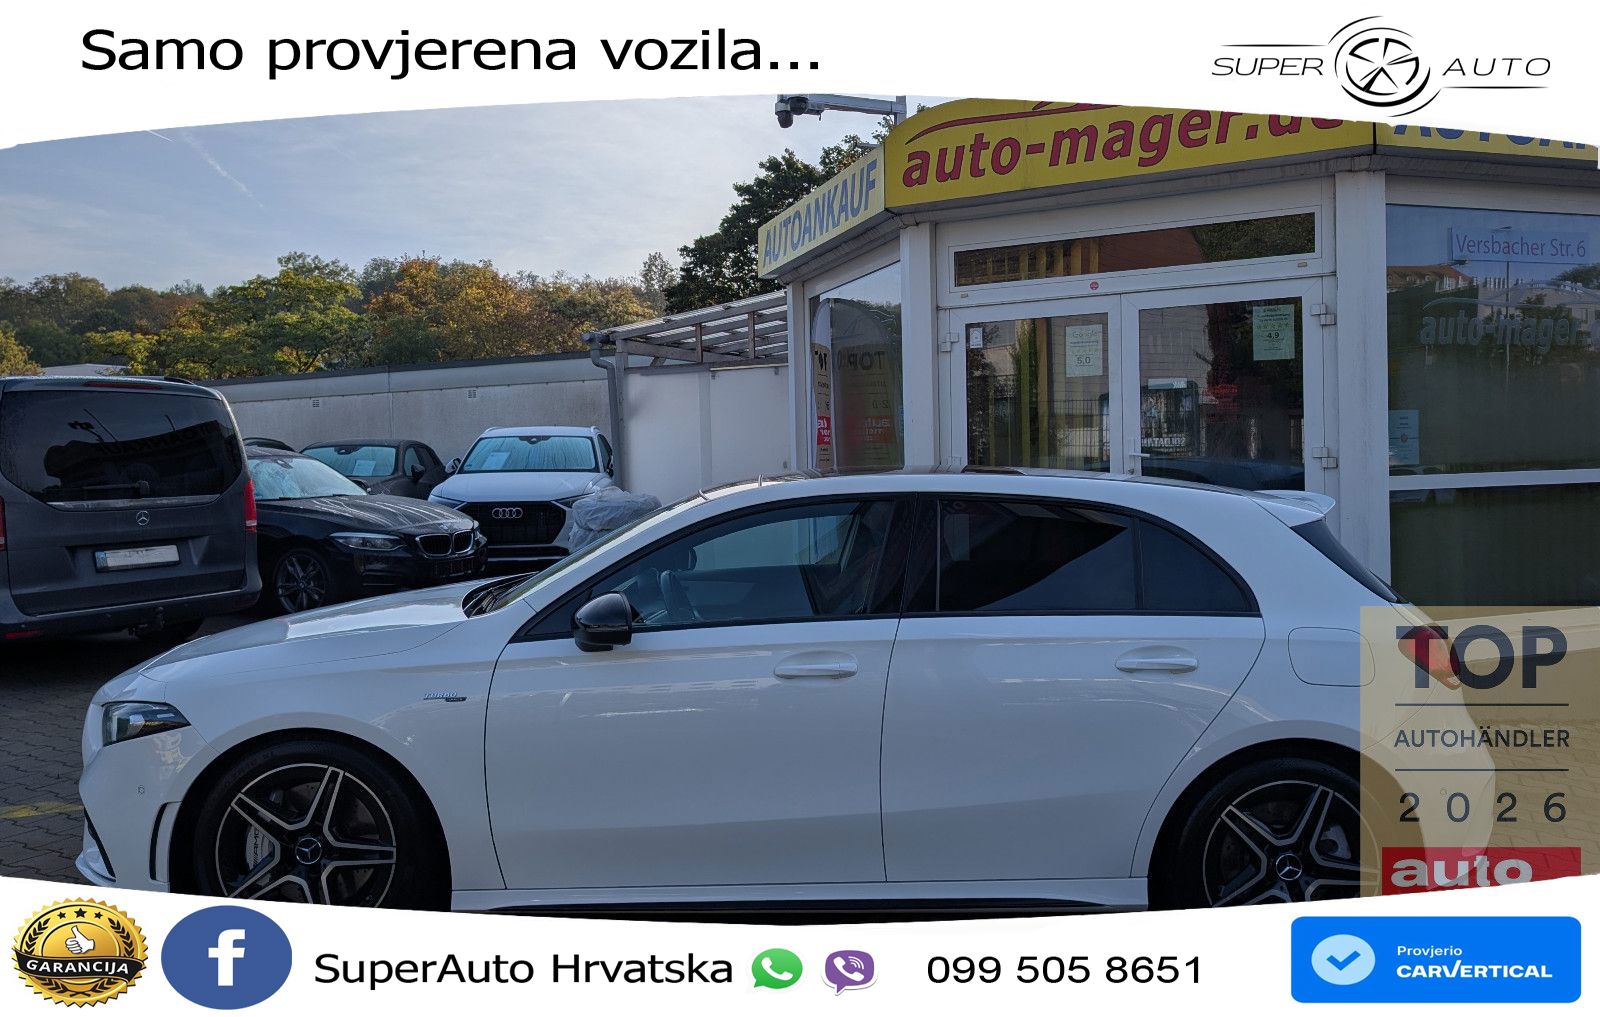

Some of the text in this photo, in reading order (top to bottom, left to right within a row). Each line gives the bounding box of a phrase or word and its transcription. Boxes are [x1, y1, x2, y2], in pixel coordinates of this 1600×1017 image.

[762, 158, 878, 268] AUTOANKAUF
[1455, 233, 1546, 256] Versbacher
[1076, 356, 1091, 365] 5,0
